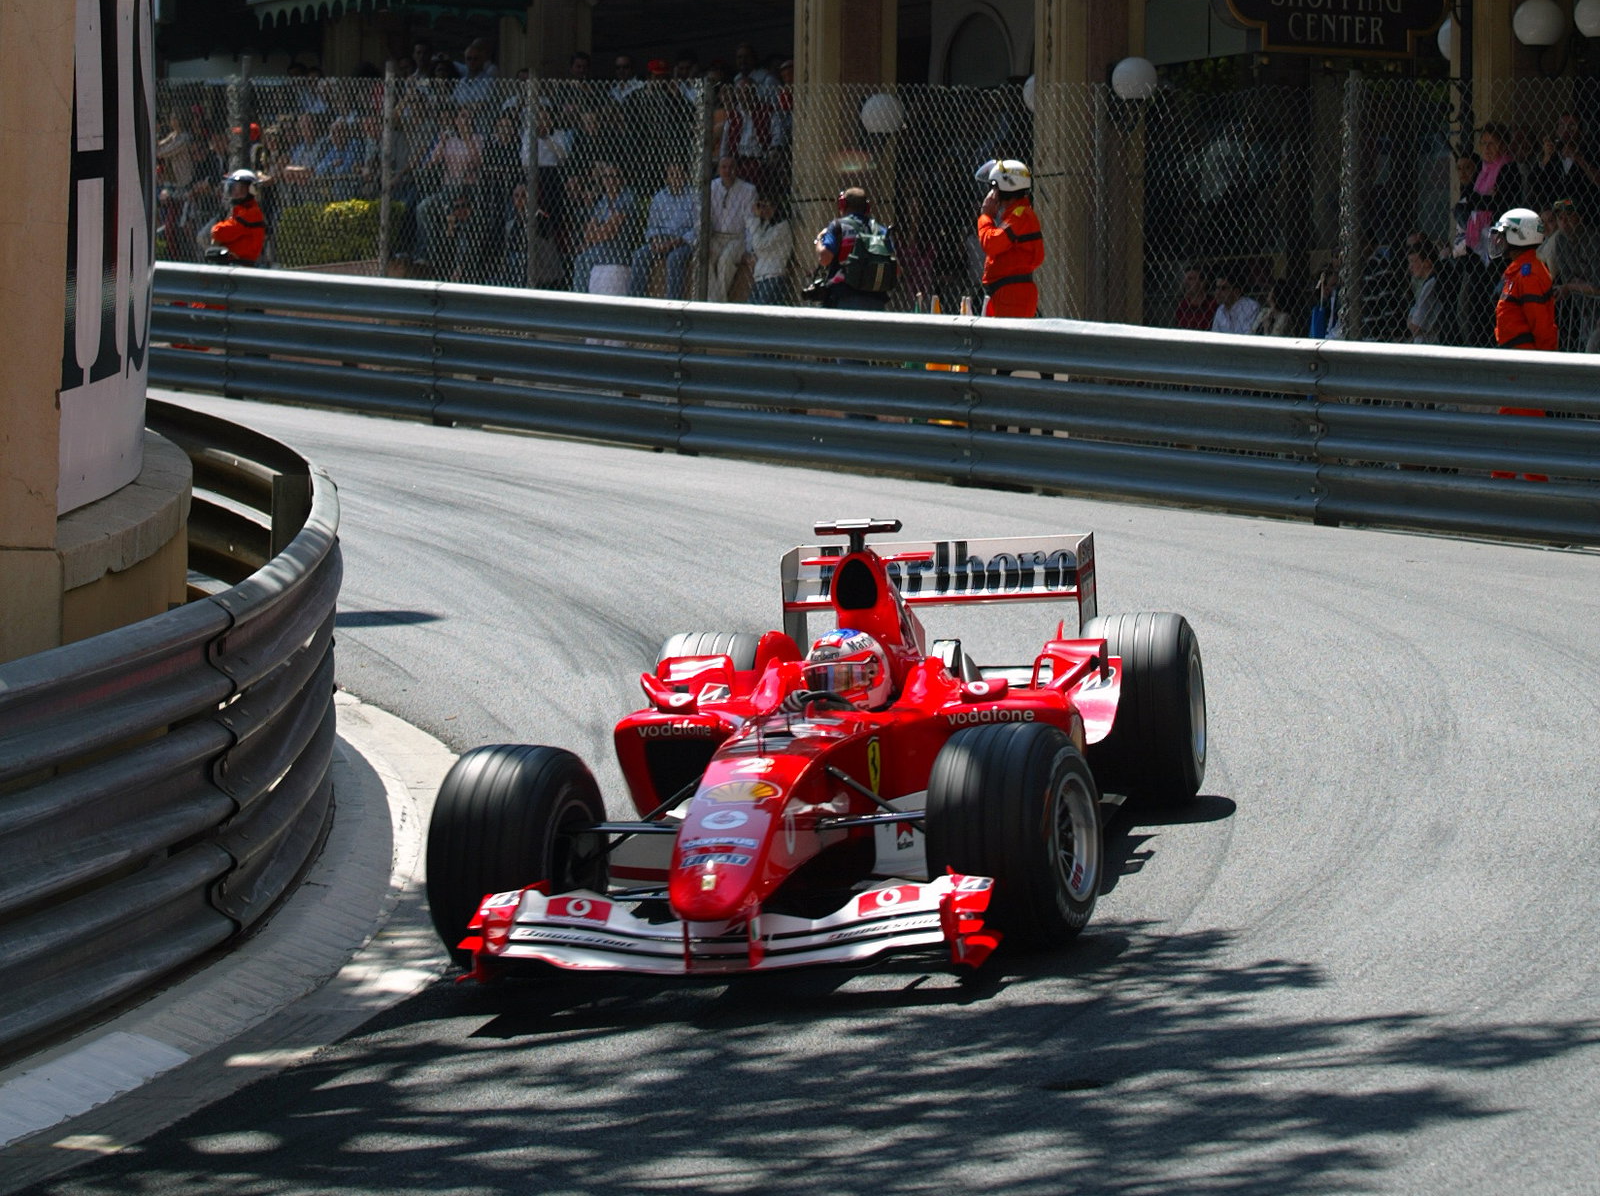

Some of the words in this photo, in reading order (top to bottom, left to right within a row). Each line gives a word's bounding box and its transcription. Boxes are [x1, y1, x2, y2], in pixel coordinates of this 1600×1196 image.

[1288, 12, 1385, 45] CENTER
[947, 708, 1035, 726] vodafone
[638, 719, 711, 738] vodafone
